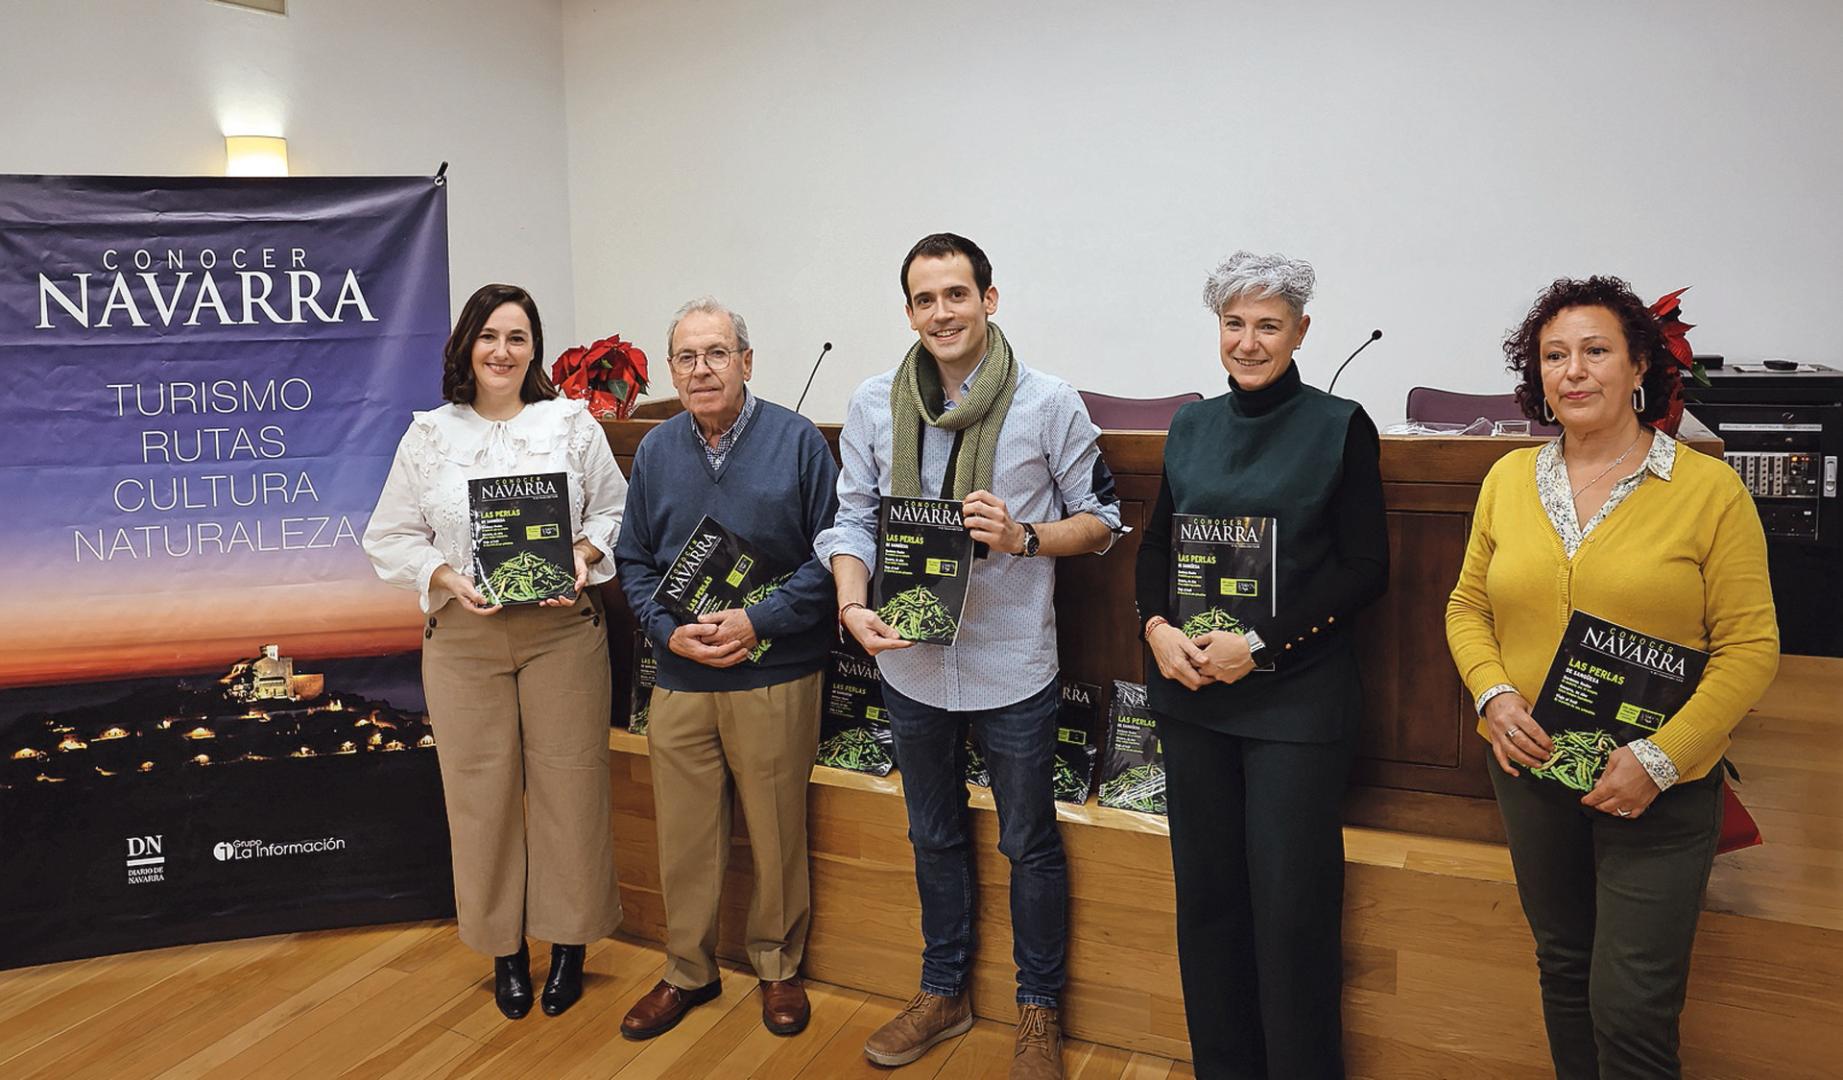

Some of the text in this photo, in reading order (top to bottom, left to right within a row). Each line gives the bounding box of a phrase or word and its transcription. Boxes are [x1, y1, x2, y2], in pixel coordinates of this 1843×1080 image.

[102, 248, 306, 271] CONOCER
[34, 268, 379, 329] NAVARRA
[106, 377, 313, 418] TURISMO
[141, 426, 287, 464] RUTAS
[113, 471, 319, 513] CULTURA
[482, 481, 557, 499] NAVARRA
[481, 509, 520, 519] LAS PERLAS
[890, 505, 962, 526] NAVARRA
[1193, 518, 1242, 526] CONOCER
[73, 515, 360, 563] NATURALEZA
[886, 534, 924, 544] LAS PERLAS
[1181, 524, 1259, 542] NAVARRA
[666, 533, 717, 600] NAVARRA
[1178, 554, 1216, 564] LAS PERLAS
[1610, 628, 1674, 653] CONOCER
[1582, 626, 1686, 677] NAVARRA
[838, 660, 881, 681] NAVAR
[1569, 658, 1625, 685] LAS PERLAS
[1132, 718, 1156, 727] PERLAS
[126, 835, 163, 857] DN
[232, 839, 263, 848] Grupo
[235, 837, 346, 860] La Información
[128, 866, 164, 877] DIARIO DE
[128, 874, 165, 885] NAVARRA
